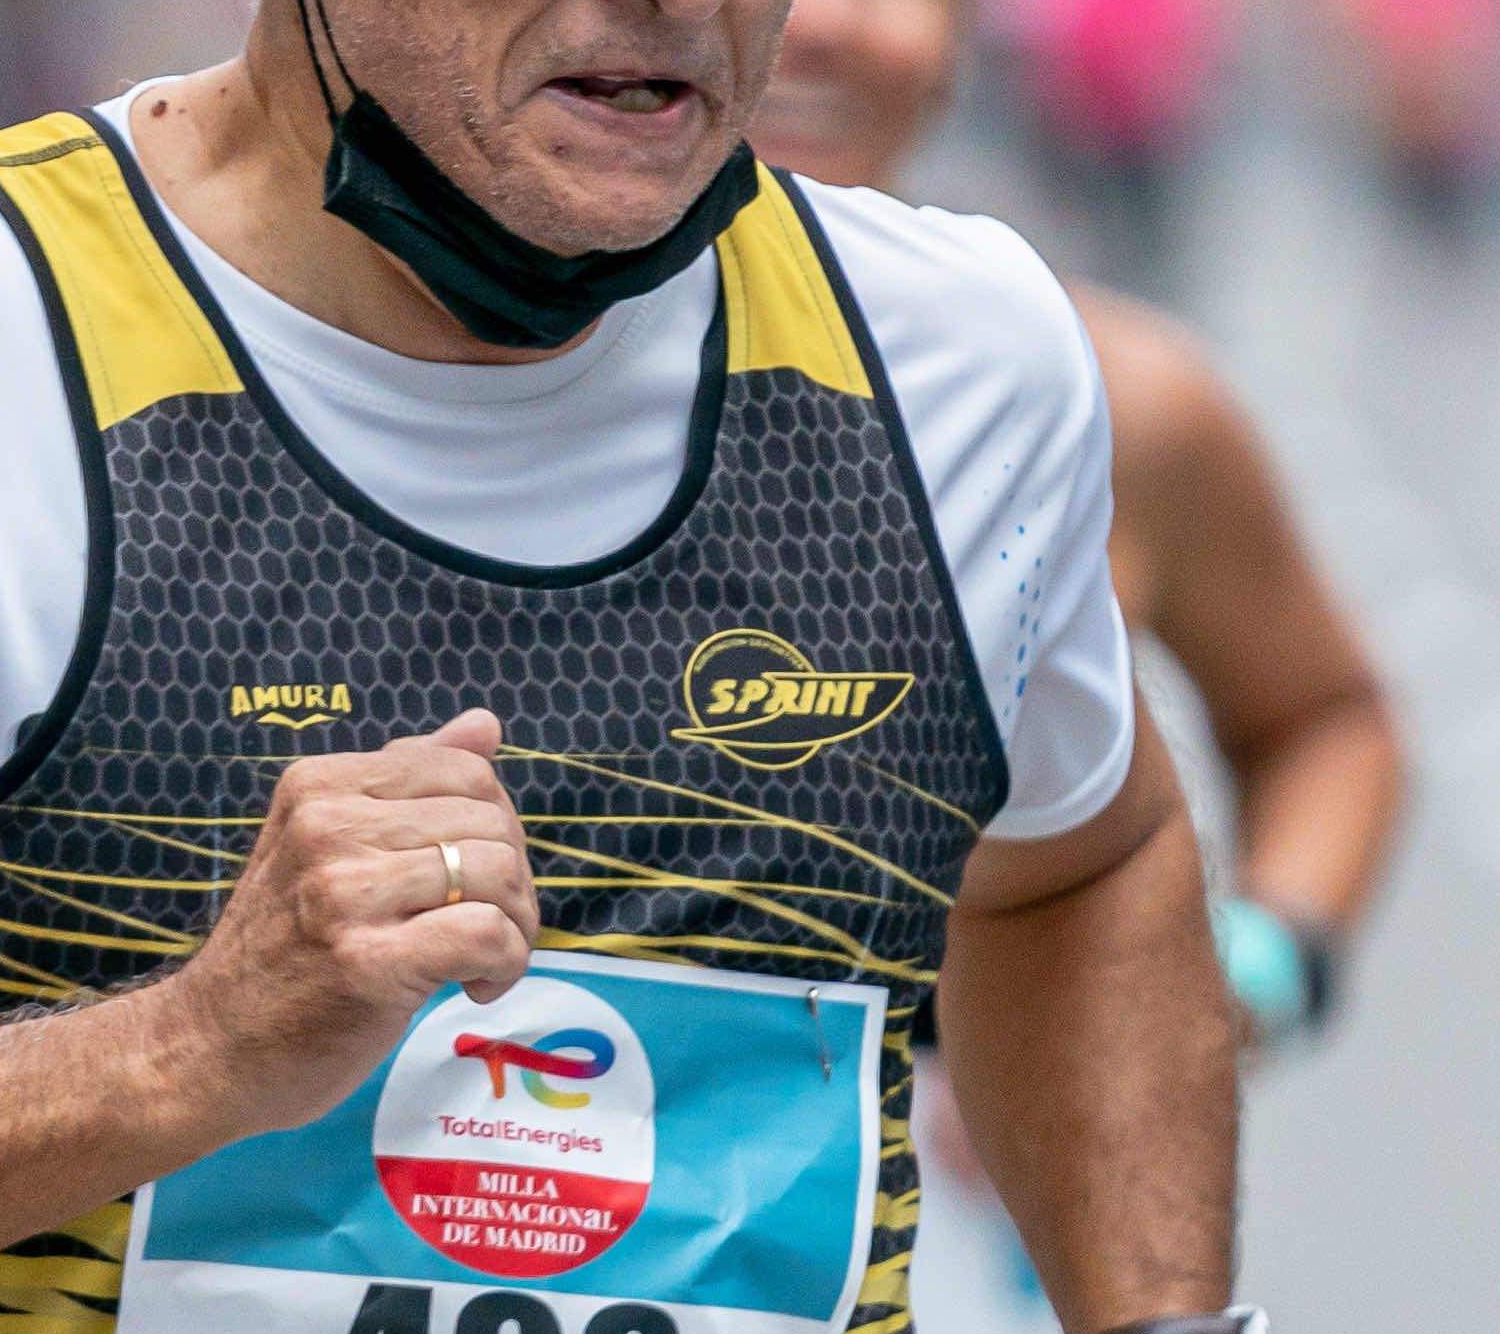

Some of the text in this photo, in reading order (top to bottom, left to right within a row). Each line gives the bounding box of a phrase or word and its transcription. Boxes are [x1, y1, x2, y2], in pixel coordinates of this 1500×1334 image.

[230, 683, 353, 716] AMURA
[706, 678, 877, 717] SPRINT
[438, 1115, 603, 1153] TotalEnergies
[476, 1171, 559, 1199] MILLA
[442, 1222, 586, 1255] DE MADRID
